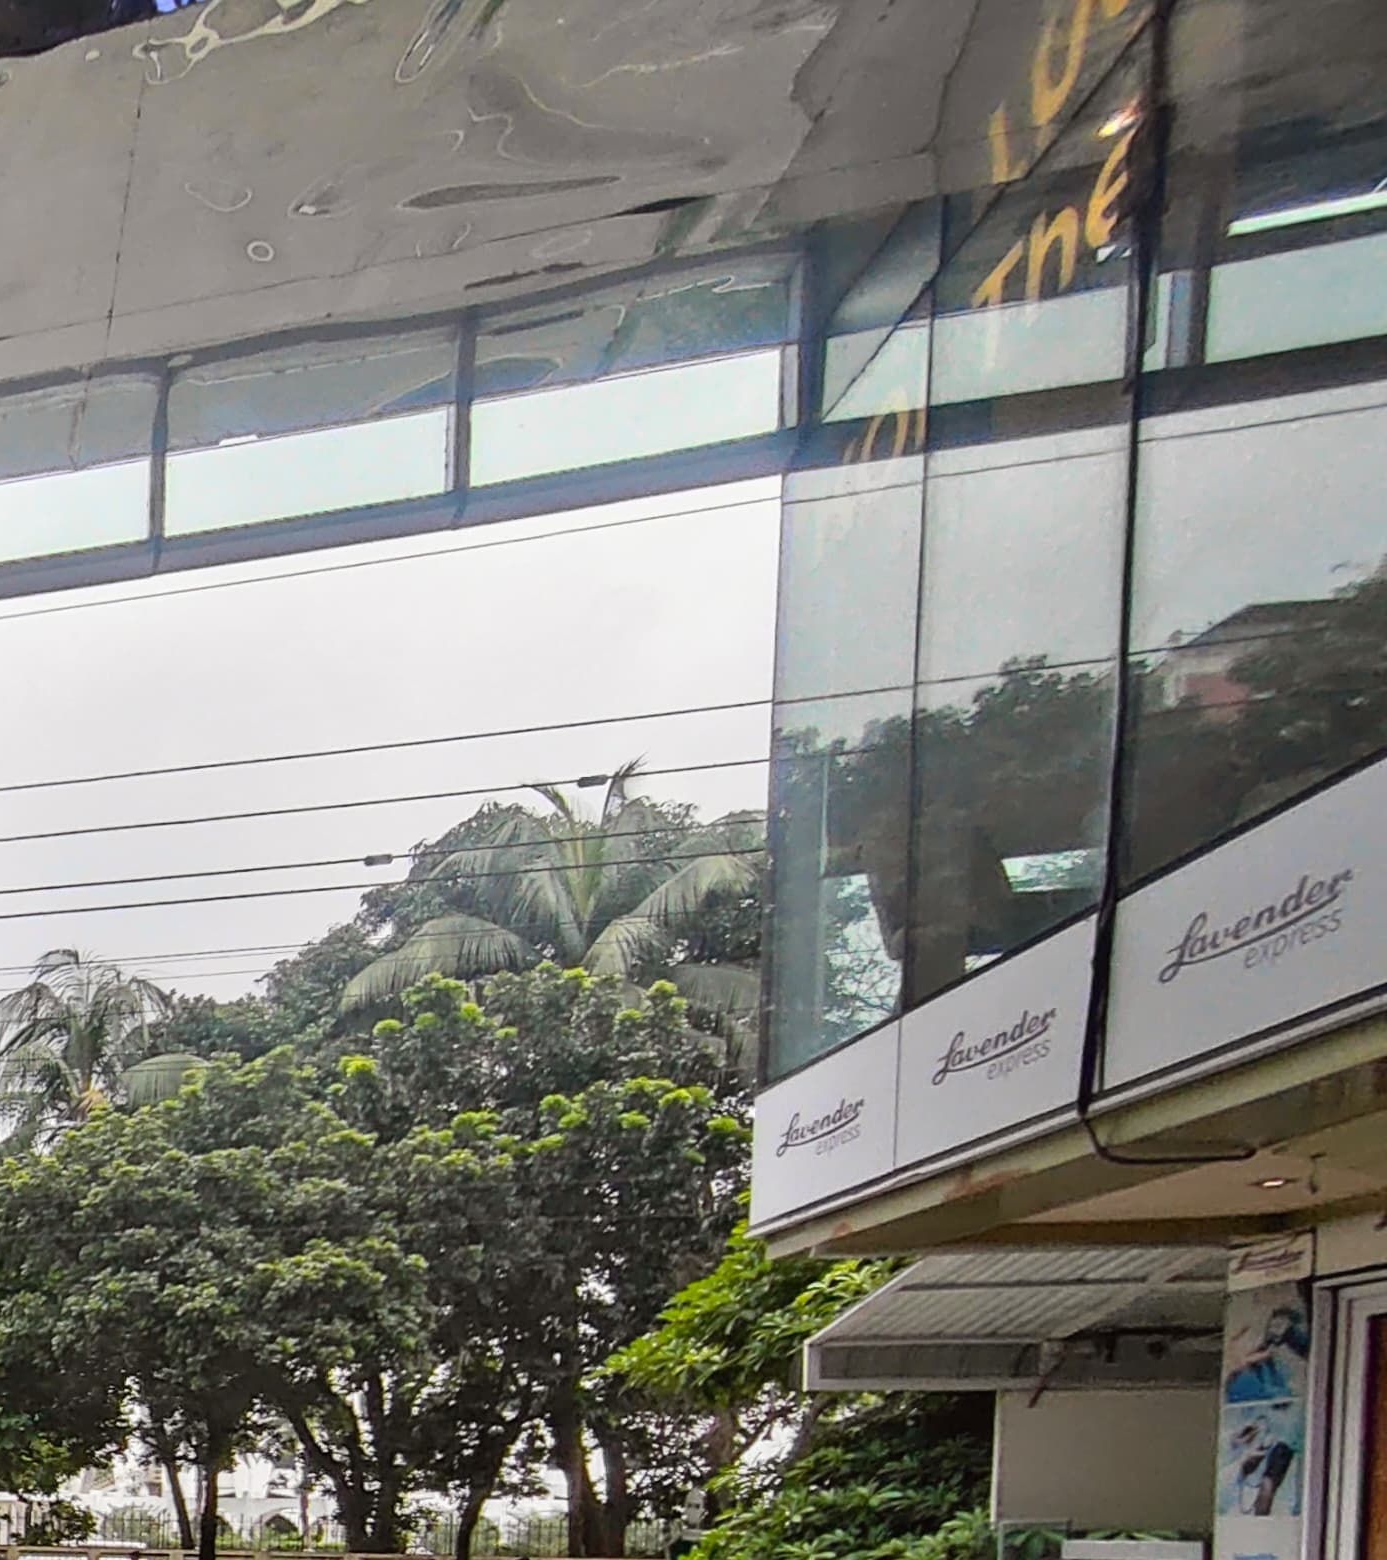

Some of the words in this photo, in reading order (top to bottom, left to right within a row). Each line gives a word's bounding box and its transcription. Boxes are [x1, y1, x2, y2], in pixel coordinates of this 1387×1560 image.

[1158, 868, 1353, 984] Lavender
[1243, 908, 1343, 970] express
[932, 1007, 1057, 1086] Lavender
[986, 1039, 1052, 1081] express
[776, 1098, 865, 1158] Lavender
